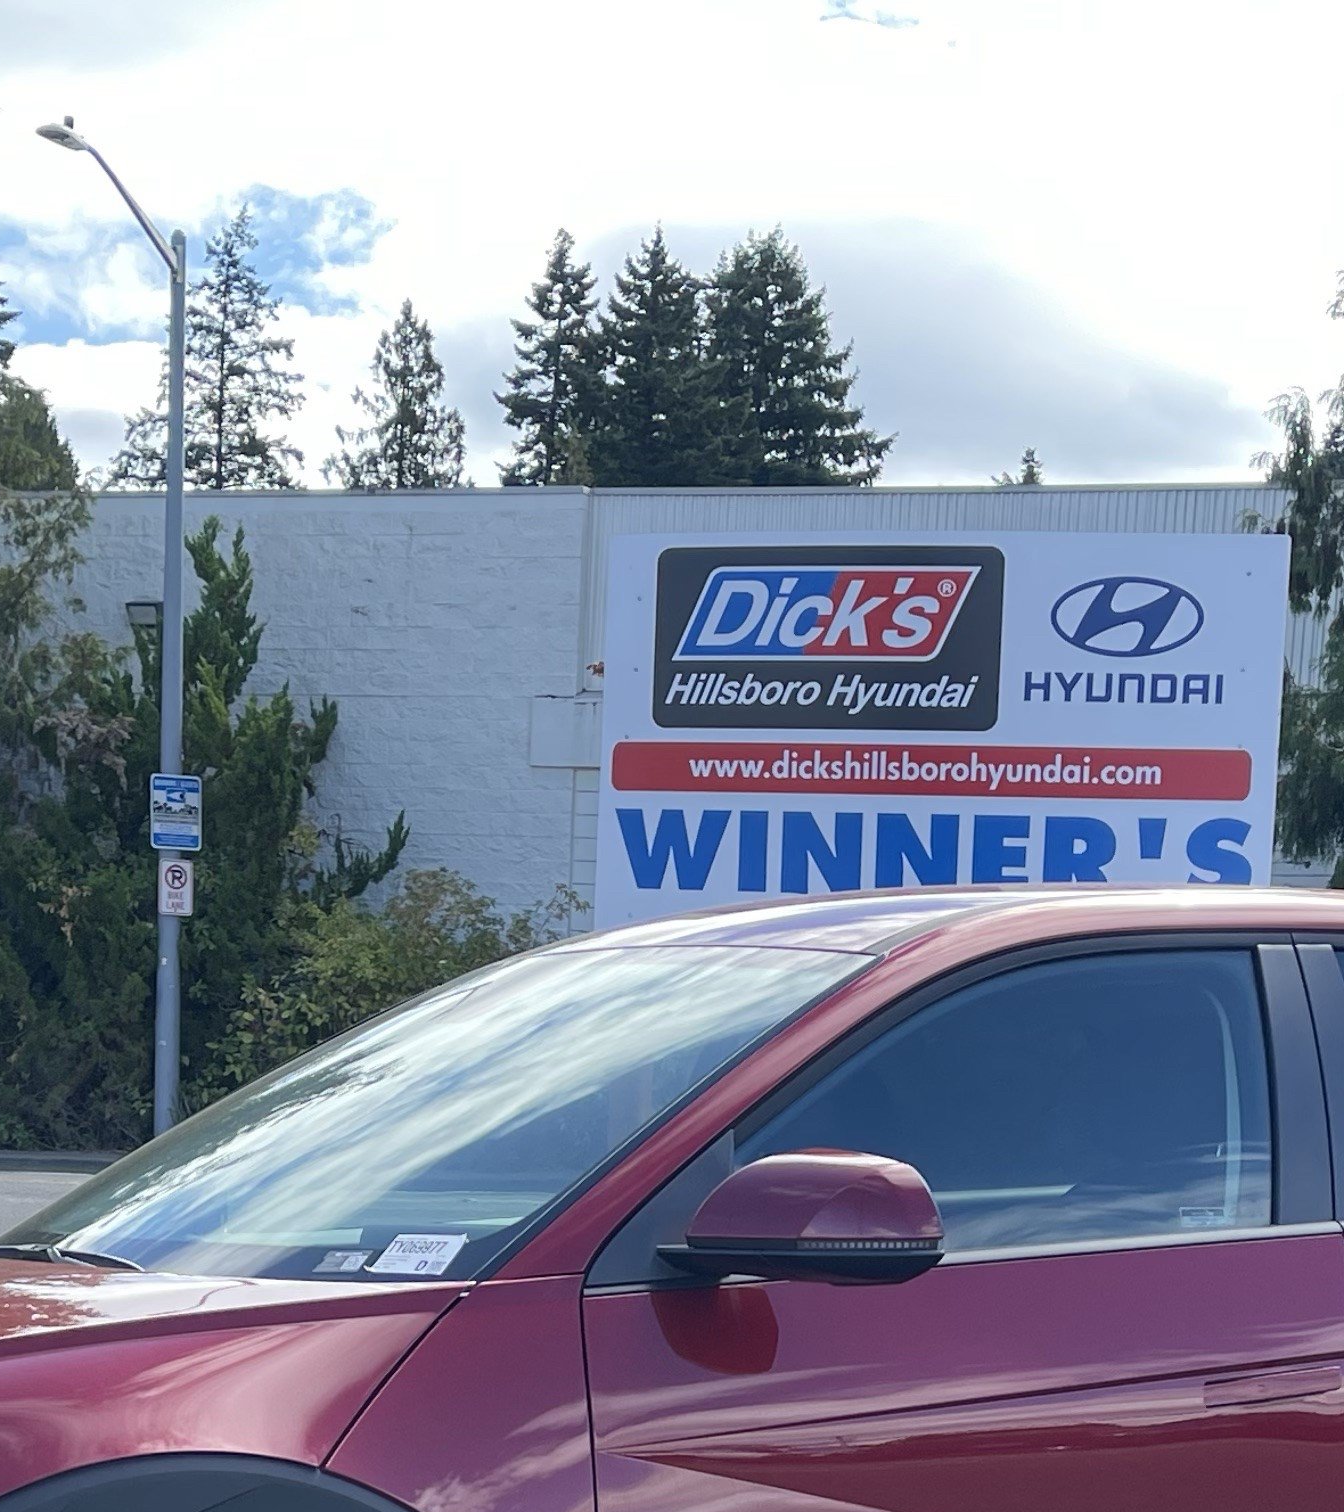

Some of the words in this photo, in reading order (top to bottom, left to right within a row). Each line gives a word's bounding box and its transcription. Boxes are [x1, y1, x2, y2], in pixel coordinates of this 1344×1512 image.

[665, 673, 821, 706] Hillsboro
[826, 674, 979, 715] Hyundai
[1024, 672, 1223, 704] HYUNDAI
[688, 751, 1162, 790] www.dickshillsborohyundai.com
[615, 808, 1253, 893] WINNER'S
